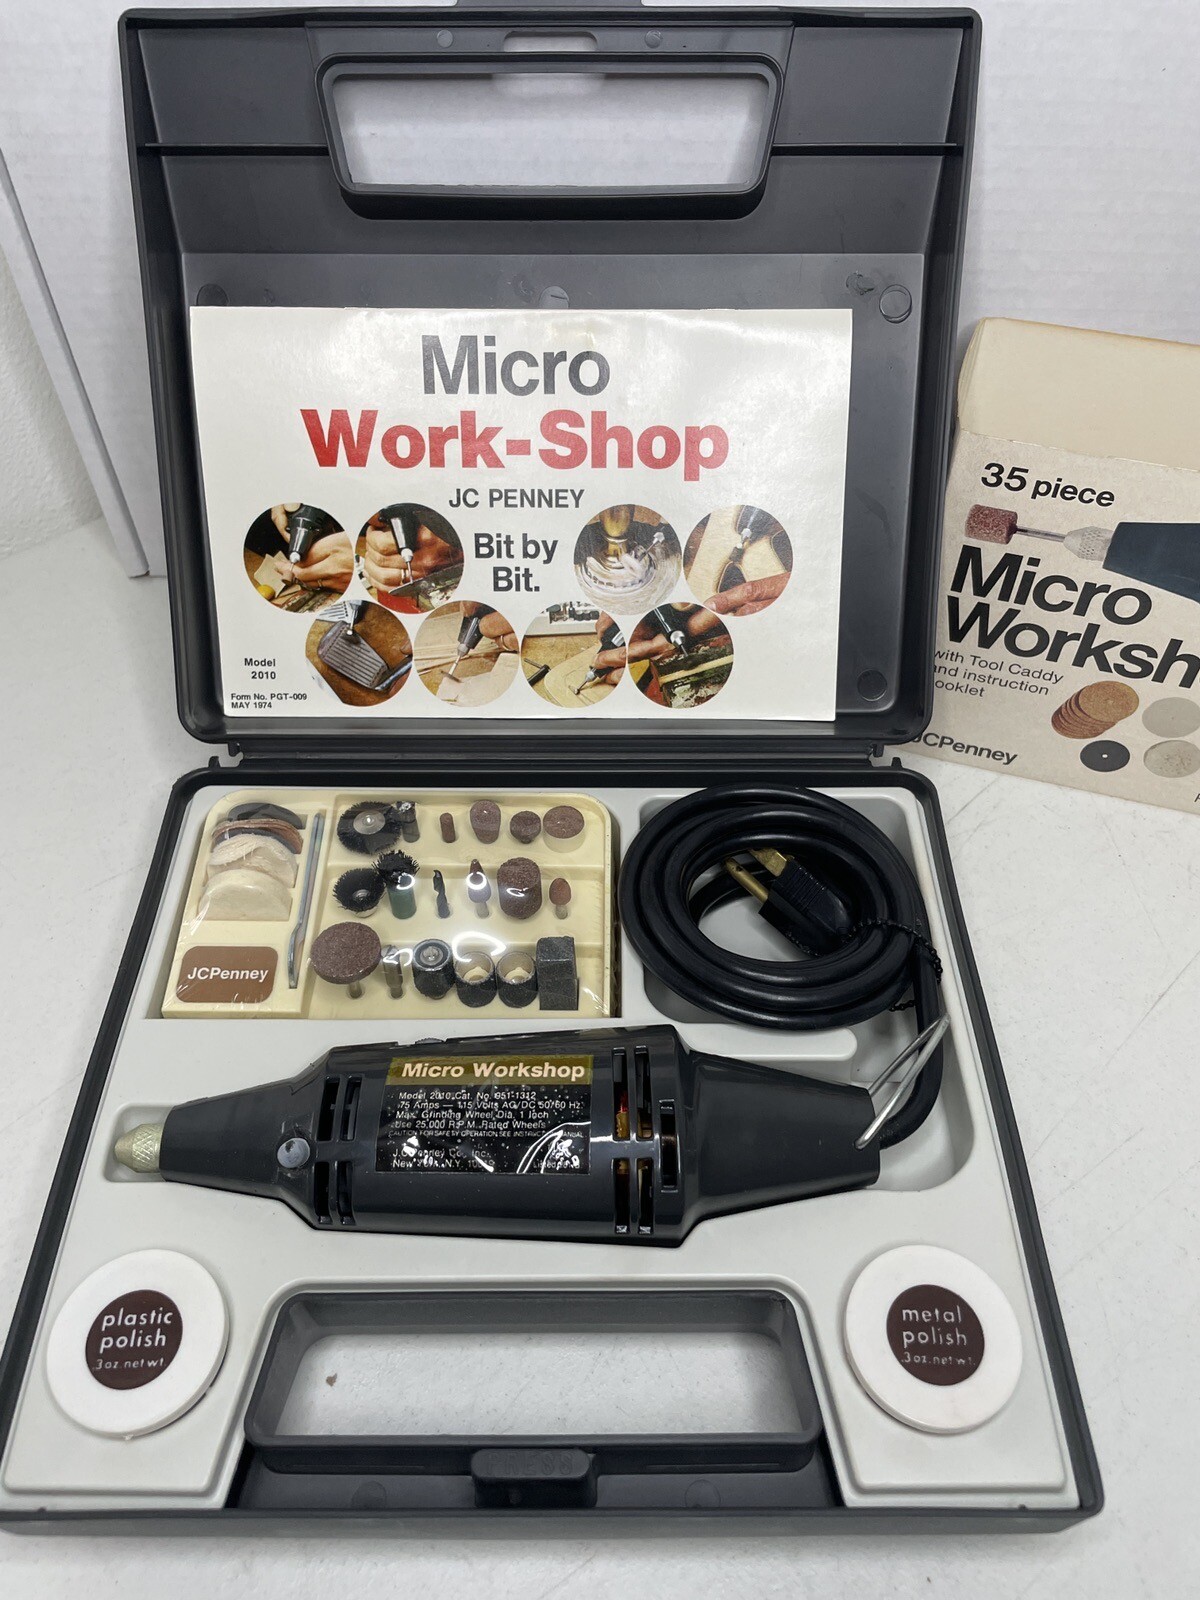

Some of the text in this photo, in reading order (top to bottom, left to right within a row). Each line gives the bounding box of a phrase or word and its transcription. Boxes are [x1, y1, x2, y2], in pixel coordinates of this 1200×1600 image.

[421, 334, 610, 396] Micro
[300, 408, 729, 481] Work-Shop
[981, 462, 1115, 507] 35 piece
[449, 488, 585, 508] JC PENNEY
[473, 532, 558, 564] Bit by
[492, 566, 540, 592] Bit.
[950, 544, 1152, 626] Micro
[244, 658, 276, 667] Model
[970, 654, 1004, 671] Tool
[1008, 663, 1064, 684] Caddy
[251, 671, 277, 679] 2010
[963, 668, 1049, 695] instruction
[934, 679, 986, 697] ooklet
[187, 967, 269, 982] JCPenney
[401, 1061, 585, 1081] Micro Workshop
[398, 1091, 426, 1100] Model
[430, 1091, 451, 1100] 2010
[413, 1100, 440, 1109] Amps
[502, 1100, 536, 1109] AC/DC
[102, 1307, 173, 1331] plastic
[902, 1305, 961, 1322] metal
[100, 1328, 166, 1353] polish
[903, 1326, 967, 1348] polish
